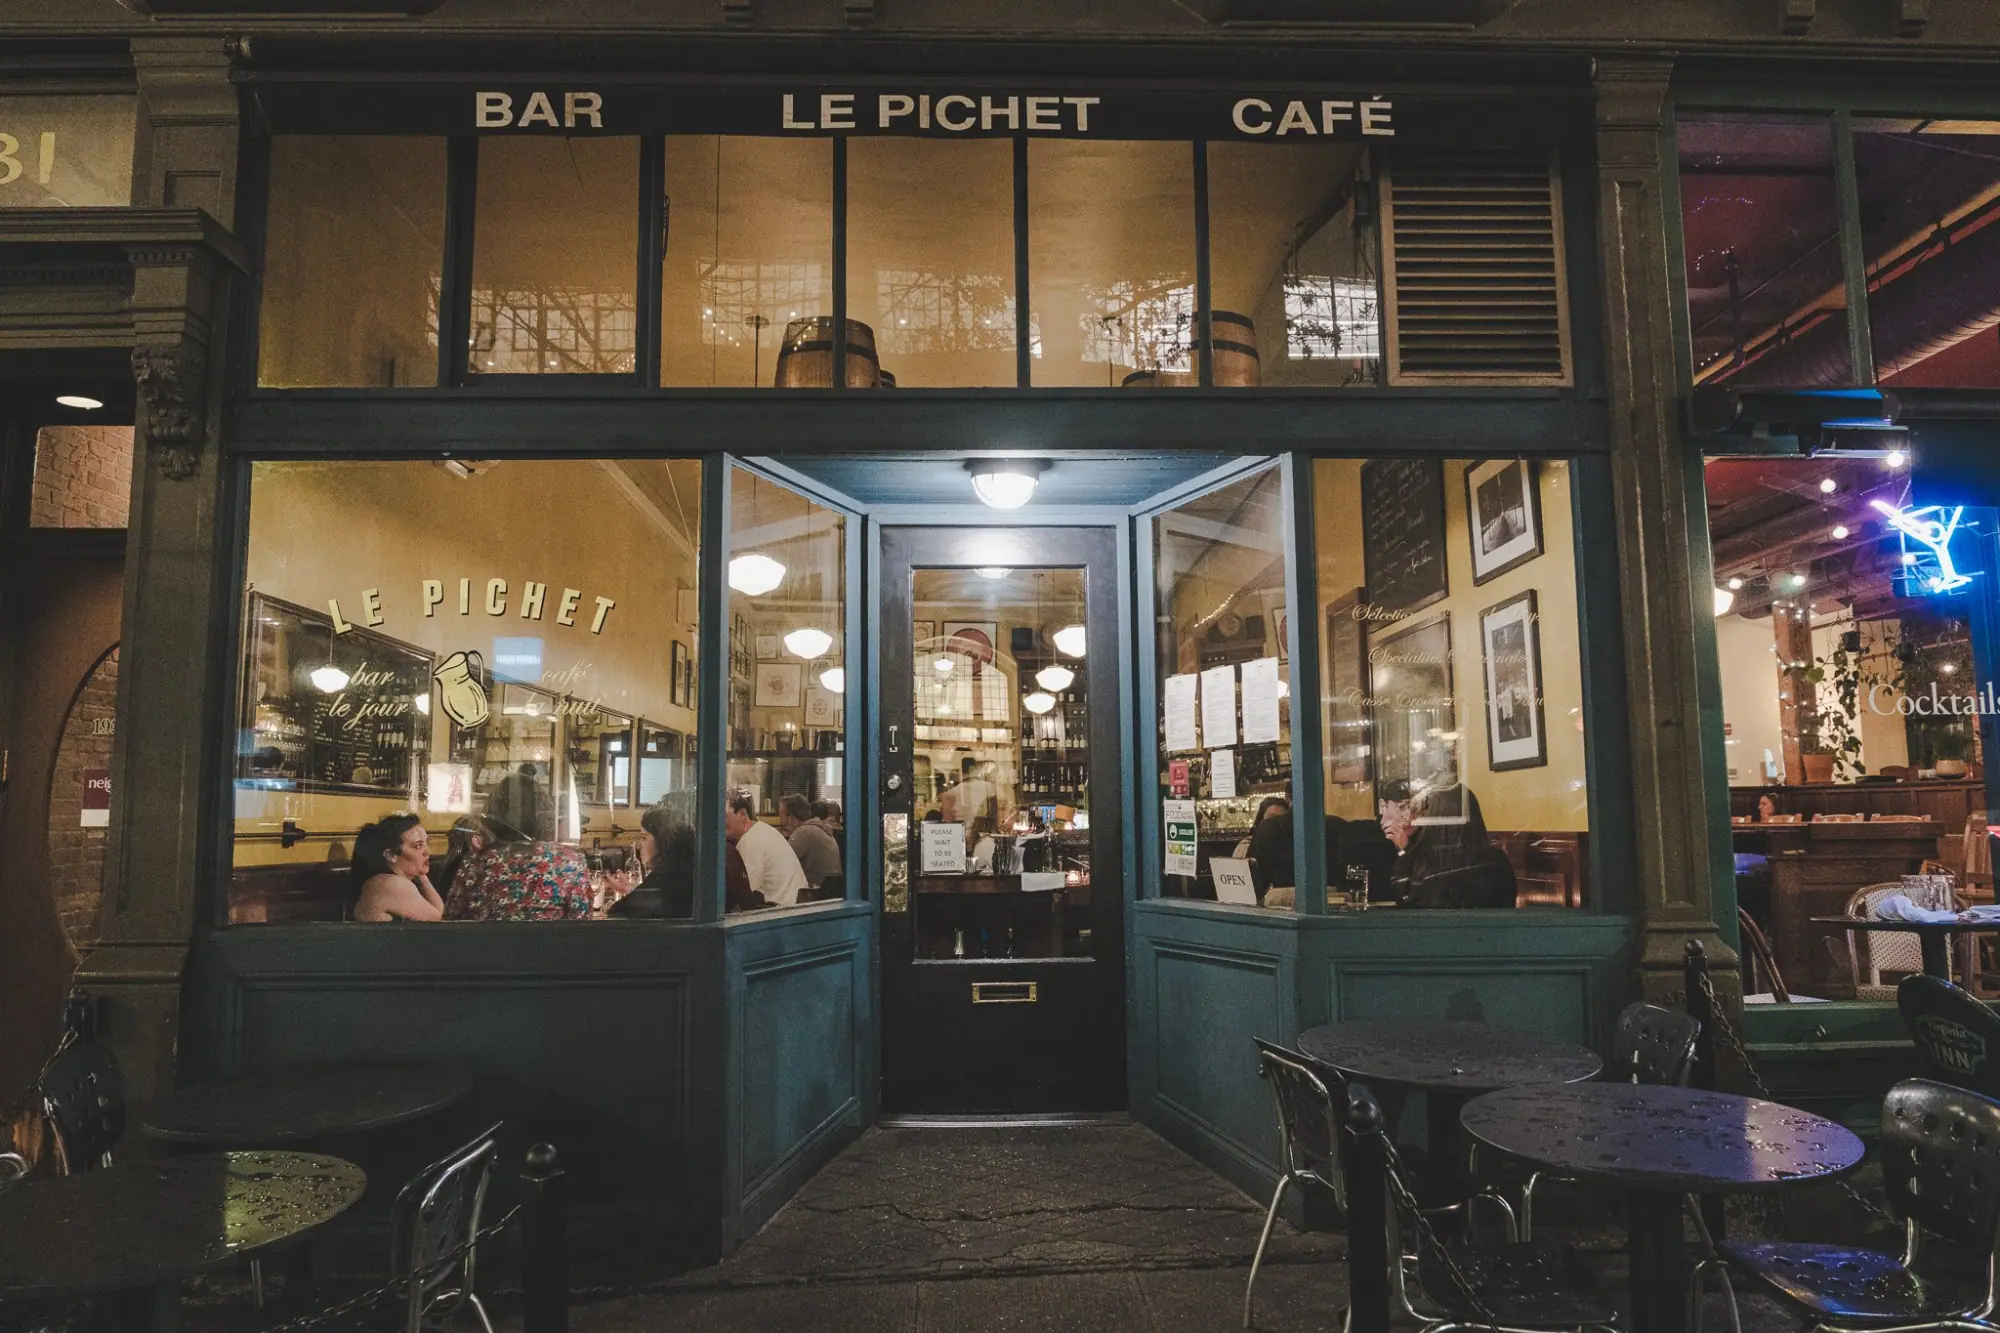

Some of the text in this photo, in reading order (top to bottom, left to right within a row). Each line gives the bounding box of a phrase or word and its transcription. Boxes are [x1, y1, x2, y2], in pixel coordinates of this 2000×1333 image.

[476, 93, 604, 127] BAR
[781, 93, 1101, 132] LE PICHET
[1231, 94, 1396, 137] CAFÉ
[328, 577, 616, 635] LE PICHET
[350, 661, 394, 686] bar
[541, 659, 595, 692] café
[329, 692, 352, 717] le
[342, 700, 409, 731] jour
[553, 697, 601, 716] nuit
[930, 828, 953, 836] PLEASE
[931, 860, 956, 868] SEATED
[1220, 873, 1247, 886] OPEN
[1925, 1019, 1967, 1038] Virginia
[1934, 1042, 1971, 1070] INN
